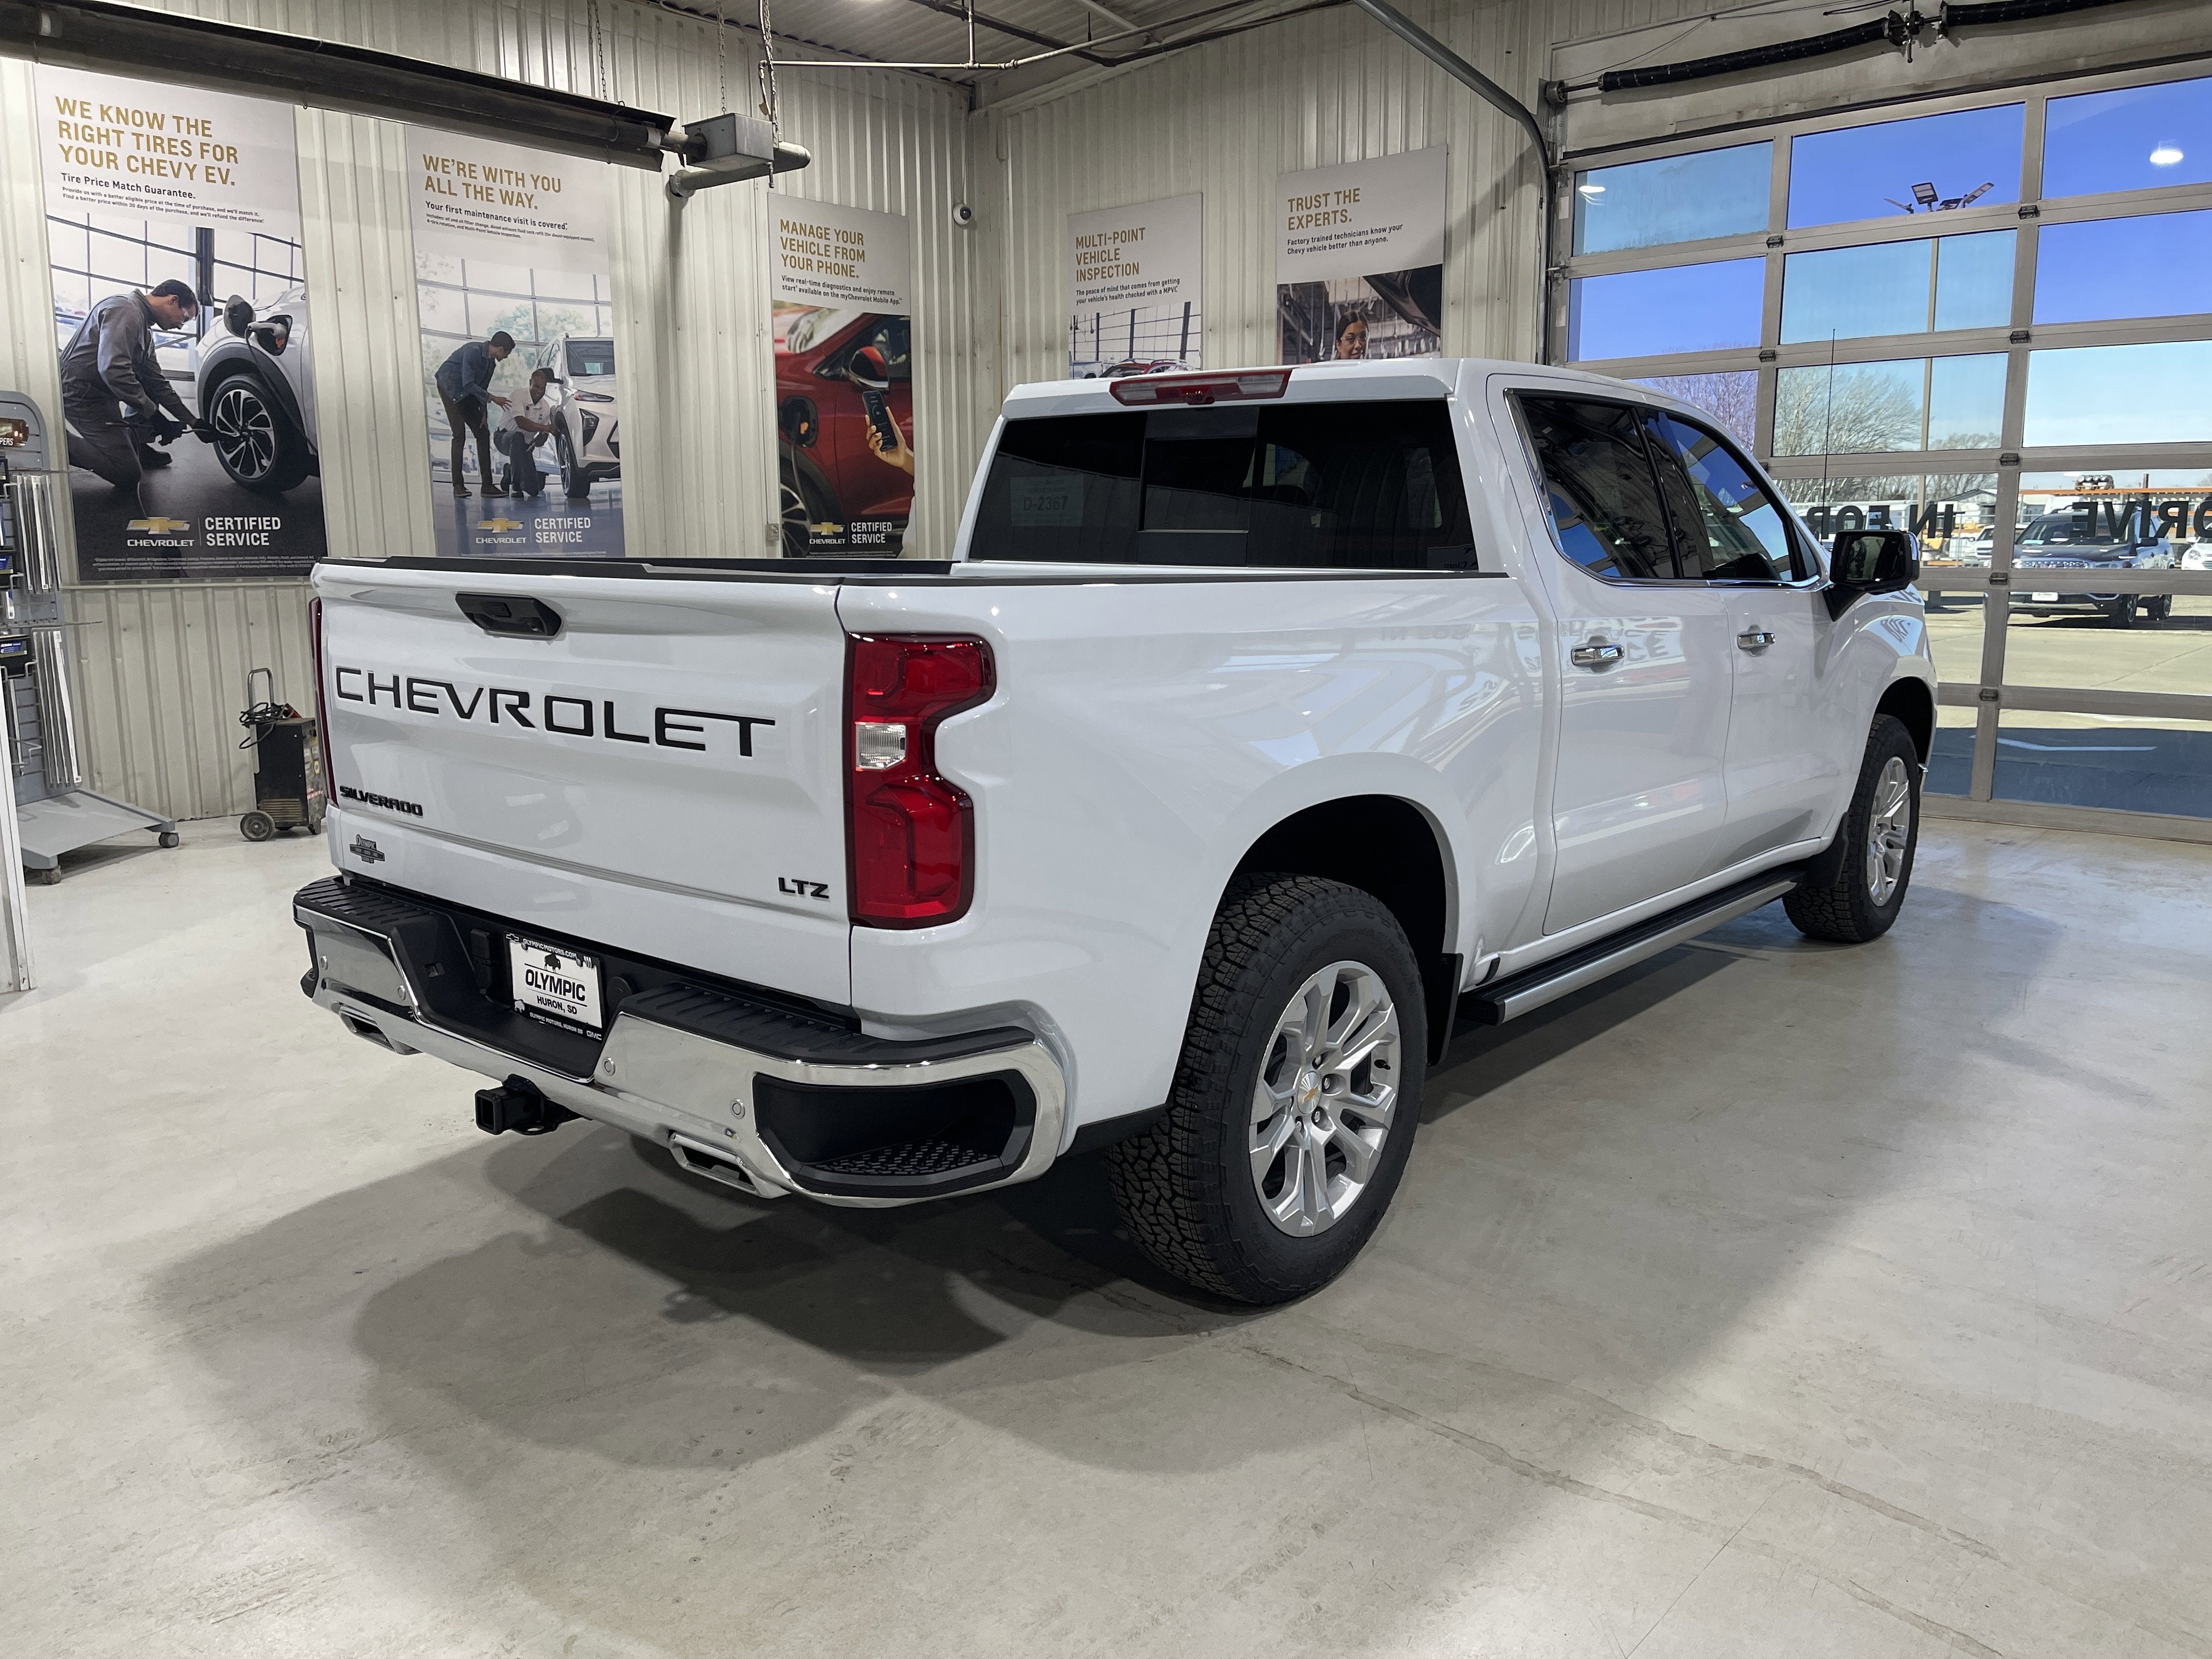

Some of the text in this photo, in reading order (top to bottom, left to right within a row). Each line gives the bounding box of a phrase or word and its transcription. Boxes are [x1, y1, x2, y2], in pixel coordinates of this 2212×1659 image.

[55, 96, 213, 138] WE KNOW THE
[58, 121, 238, 163] RIGHT TIRES FOR
[58, 144, 235, 186] YOUR CHEVY EV.
[422, 154, 562, 193] WE'RE WITH YOU
[61, 172, 196, 199] Tire Price Match Guarantee.
[425, 176, 538, 210] ALL THE WAY.
[1287, 188, 1361, 213] TRUST THE
[426, 200, 443, 211] Your
[445, 205, 462, 215] first
[464, 210, 511, 223] maintenance
[513, 217, 528, 225] visit
[1288, 208, 1352, 231] EXPERTS.
[780, 219, 864, 246] MANAGE YOUR
[1075, 227, 1146, 250] MULTI-POINT
[1287, 223, 1403, 246] Factory trained technicians know your
[780, 236, 865, 263] VEHICLE FROM
[1306, 244, 1327, 253] vehicle
[1328, 242, 1347, 250] better
[1364, 236, 1389, 246] anyone.
[781, 253, 859, 279] YOUR PHONE.
[1075, 247, 1121, 266] VEHICLE
[1076, 262, 1140, 283] INSPECTION
[1161, 278, 1180, 287] getting
[796, 278, 821, 287] real-time
[822, 281, 851, 291] diagnostics
[798, 287, 822, 296] available
[840, 294, 872, 302] myChevrolet
[1087, 295, 1108, 303] vehicle's
[205, 516, 281, 531] CERTIFIED
[534, 517, 591, 529] CERTIFIED
[851, 522, 893, 532] CERTIFIED
[127, 539, 194, 548] CHEVROLET
[206, 532, 269, 546] SERVICE
[535, 531, 583, 543] SERVICE
[851, 534, 886, 544] SERVICE
[336, 666, 776, 757] CHEVROLET
[340, 785, 423, 816] SILVERADO
[778, 877, 830, 899] LTZ
[525, 969, 585, 1001] OLYMPIC
[537, 996, 578, 1014] HURON, SD
[586, 1030, 602, 1040] GMC
